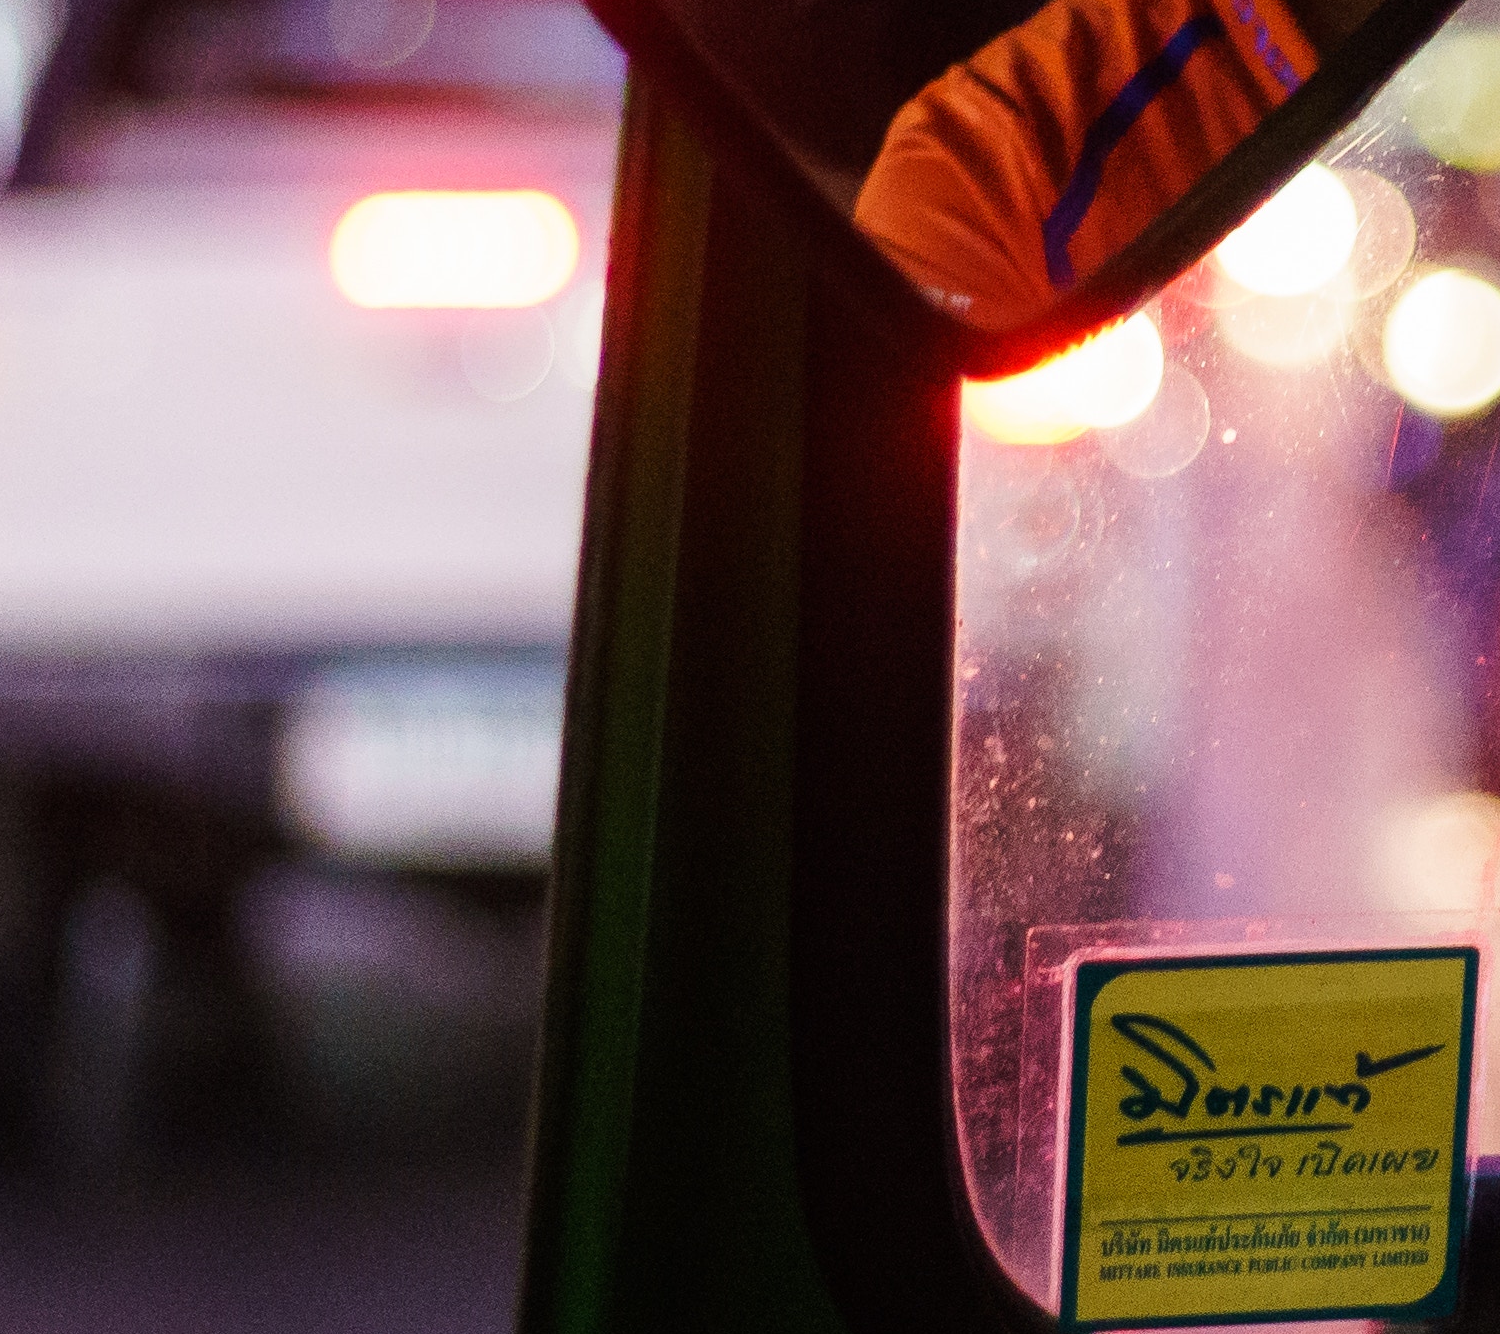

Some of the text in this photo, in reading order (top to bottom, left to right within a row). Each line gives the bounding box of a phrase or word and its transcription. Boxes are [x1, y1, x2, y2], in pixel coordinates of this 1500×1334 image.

[1169, 1139, 1440, 1184] จริงใจ เปิดเผย
[1100, 1228, 1152, 1259] บริษัท
[1306, 1220, 1350, 1248] จำกัด
[1352, 1221, 1431, 1247] (มหาชน)
[1299, 1251, 1366, 1272] COMPANY
